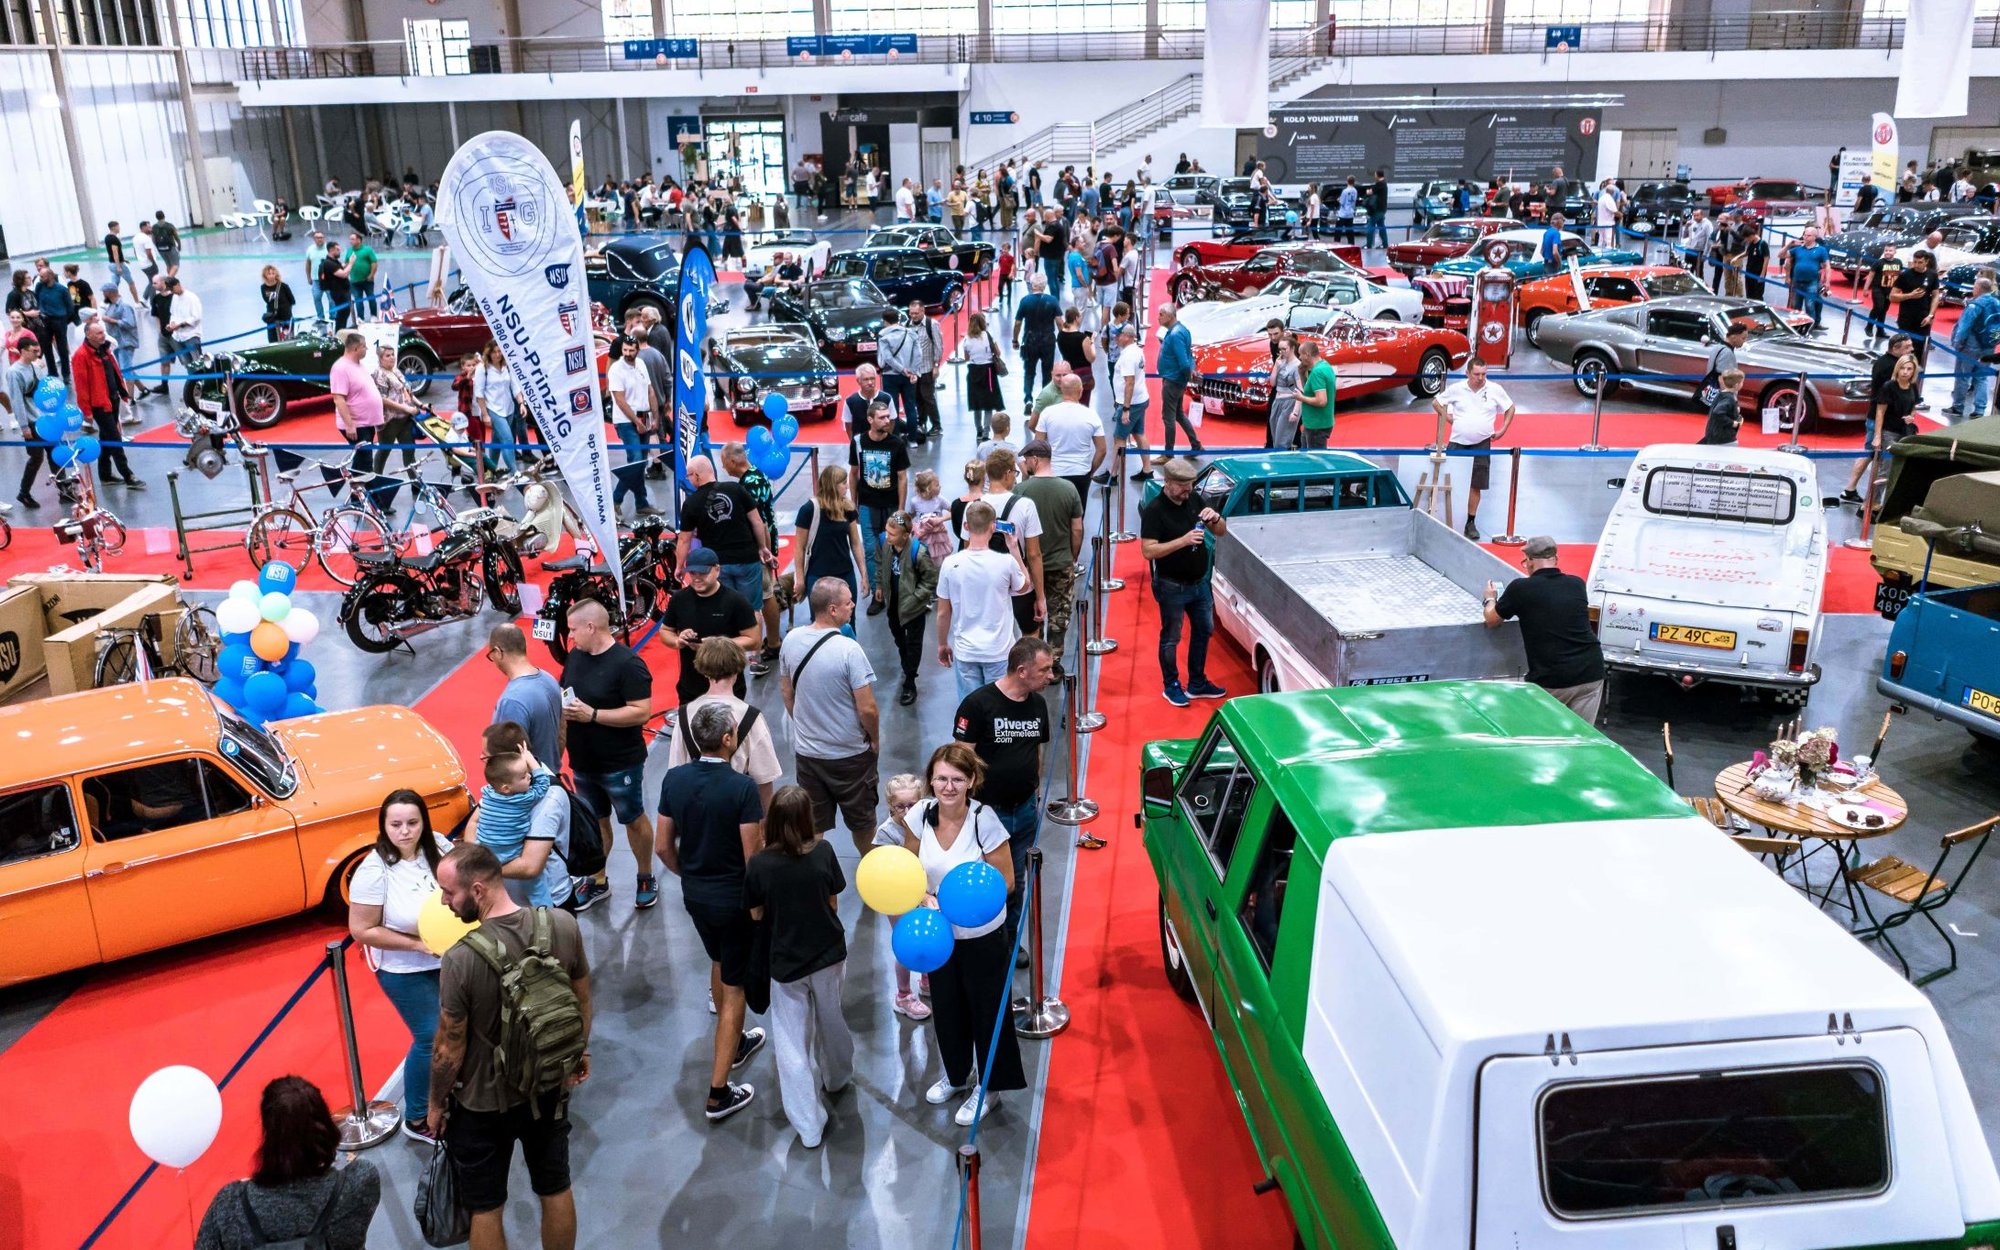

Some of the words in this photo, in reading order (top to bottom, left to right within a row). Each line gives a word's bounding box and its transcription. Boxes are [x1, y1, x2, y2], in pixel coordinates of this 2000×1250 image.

[983, 114, 992, 122] 10
[549, 267, 567, 284] NSU
[497, 294, 572, 438] NSU-Prinz-IG
[567, 350, 584, 372] NSU
[481, 297, 495, 317] von
[491, 318, 508, 341] 1980
[503, 342, 517, 361] e.V.
[512, 362, 527, 381] und
[522, 381, 562, 453] NSU-Zweirad-IG
[587, 433, 607, 525] www.nsu-ig.de
[267, 565, 288, 581] NSU
[1878, 584, 1908, 601] KOD
[1877, 601, 1901, 613] 489
[534, 630, 552, 639] NSU1
[1660, 626, 1679, 641] PZ
[1684, 629, 1711, 643] 49C
[0, 640, 17, 672] SU
[1373, 677, 1408, 685] TRUCK
[1971, 691, 1990, 709] PO
[994, 718, 1039, 730] Diverse
[994, 729, 1040, 738] ExtremeTeam
